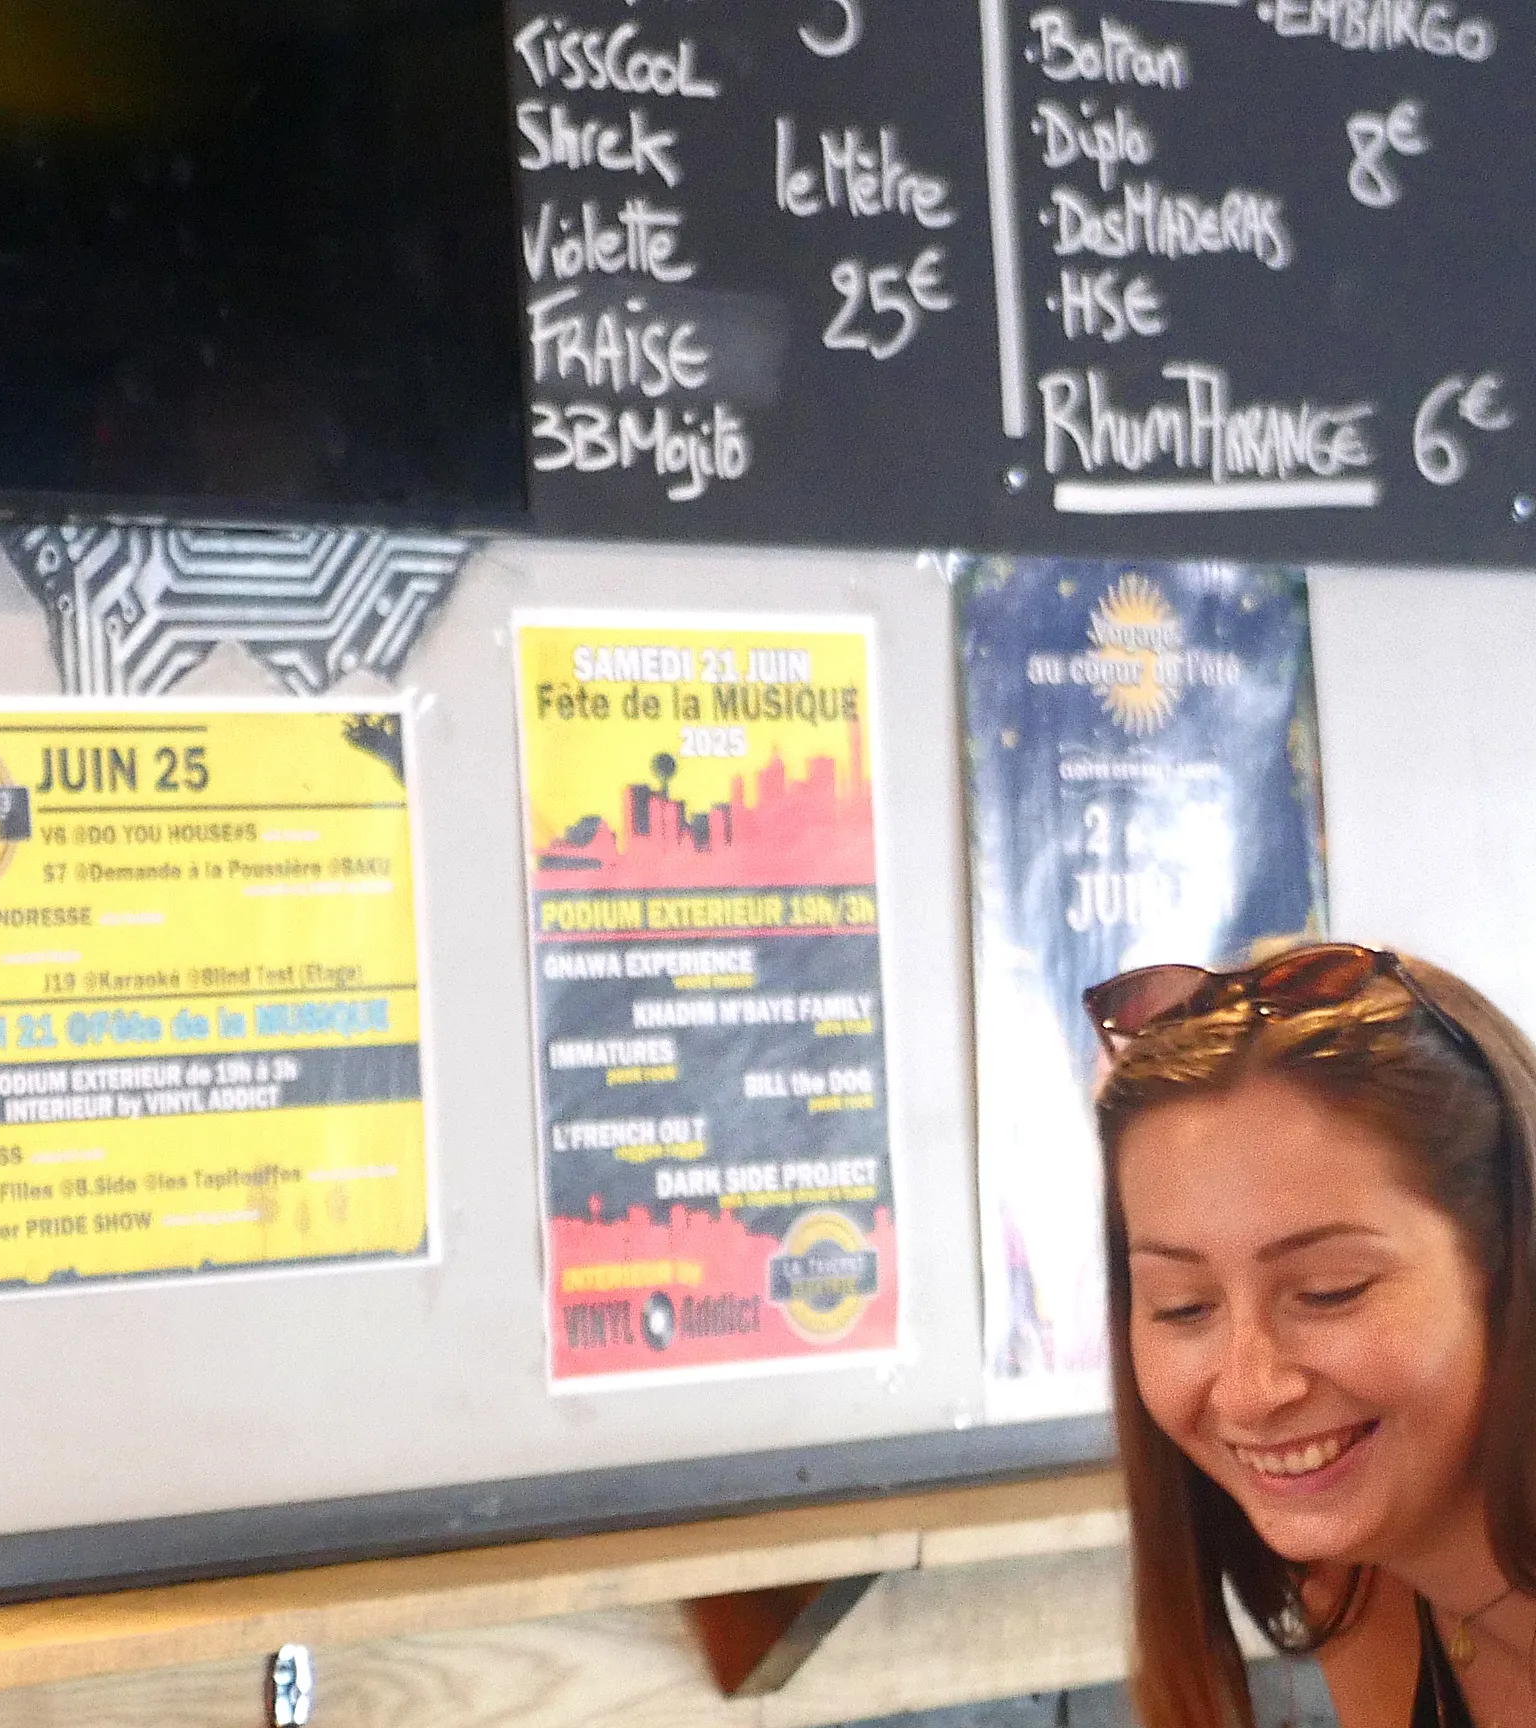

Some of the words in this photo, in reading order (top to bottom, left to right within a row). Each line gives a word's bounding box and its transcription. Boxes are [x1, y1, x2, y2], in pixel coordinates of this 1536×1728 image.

[515, 101, 682, 188] Shrek
[1037, 101, 1152, 190] Diplo
[522, 199, 696, 284] Violette
[822, 246, 954, 362] 25€
[1060, 269, 1166, 343] HSE
[573, 646, 693, 682] SAMEDI
[701, 649, 739, 683] 21
[746, 649, 811, 683] JUIN
[536, 683, 610, 721] Fête
[622, 684, 660, 721] de
[672, 688, 701, 721] la
[712, 684, 859, 726] MUSIQUE
[678, 727, 747, 758] 2025
[37, 746, 136, 794] JUIN
[154, 746, 209, 792] 25
[123, 823, 161, 845] YOU
[542, 898, 642, 931] PODIUM
[648, 895, 783, 929] EXTERIEUR
[625, 946, 755, 979] EXPERIENCE
[16, 1012, 59, 1049] 21
[171, 1006, 211, 1041] de
[255, 997, 390, 1038] MUSIQUE
[799, 992, 873, 1022] FAMILY
[70, 1060, 181, 1094] EXTERIEUR
[186, 1061, 213, 1086] de
[5, 1093, 112, 1123] INTERIEUR
[117, 1090, 143, 1120] by
[144, 1087, 206, 1116] VINYL
[207, 1083, 281, 1111] ADDICT
[655, 1167, 723, 1199] DARK
[725, 1164, 779, 1195] SIDE
[782, 1158, 878, 1190] PROJECT
[26, 1214, 88, 1239] PRIDE
[94, 1211, 153, 1234] SHOW
